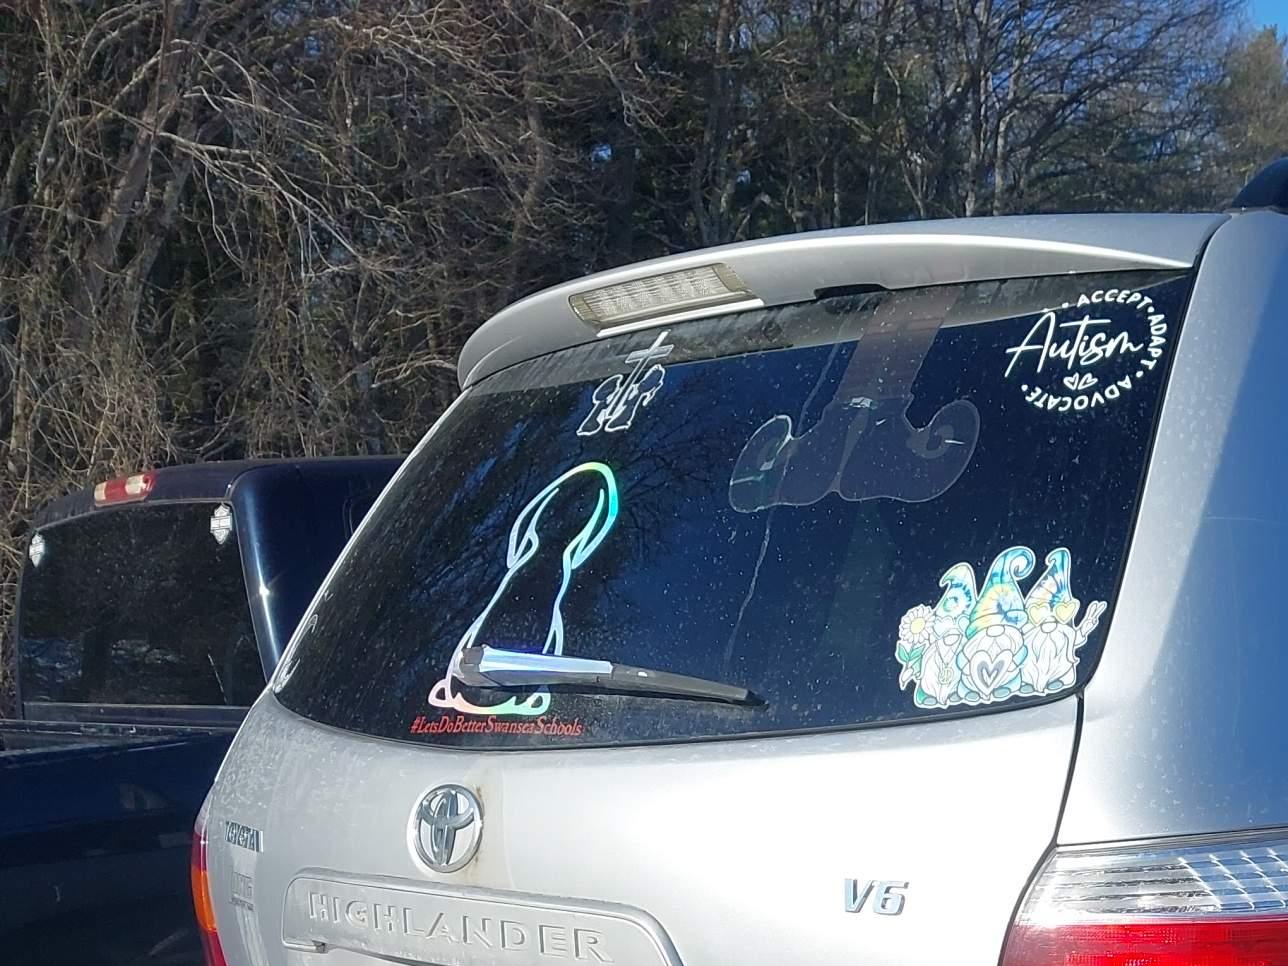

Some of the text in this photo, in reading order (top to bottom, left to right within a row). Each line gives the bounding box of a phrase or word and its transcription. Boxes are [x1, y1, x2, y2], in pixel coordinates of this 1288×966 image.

[1076, 289, 1152, 309] ACCEPT
[1004, 311, 1144, 378] Autism
[1139, 314, 1168, 371] ADAPT
[1024, 375, 1133, 411] ADVOCATE
[410, 714, 583, 737] #LetsDoBetterSwanseaSchools
[843, 877, 910, 916] V6
[307, 891, 615, 964] HIGHLANDER
